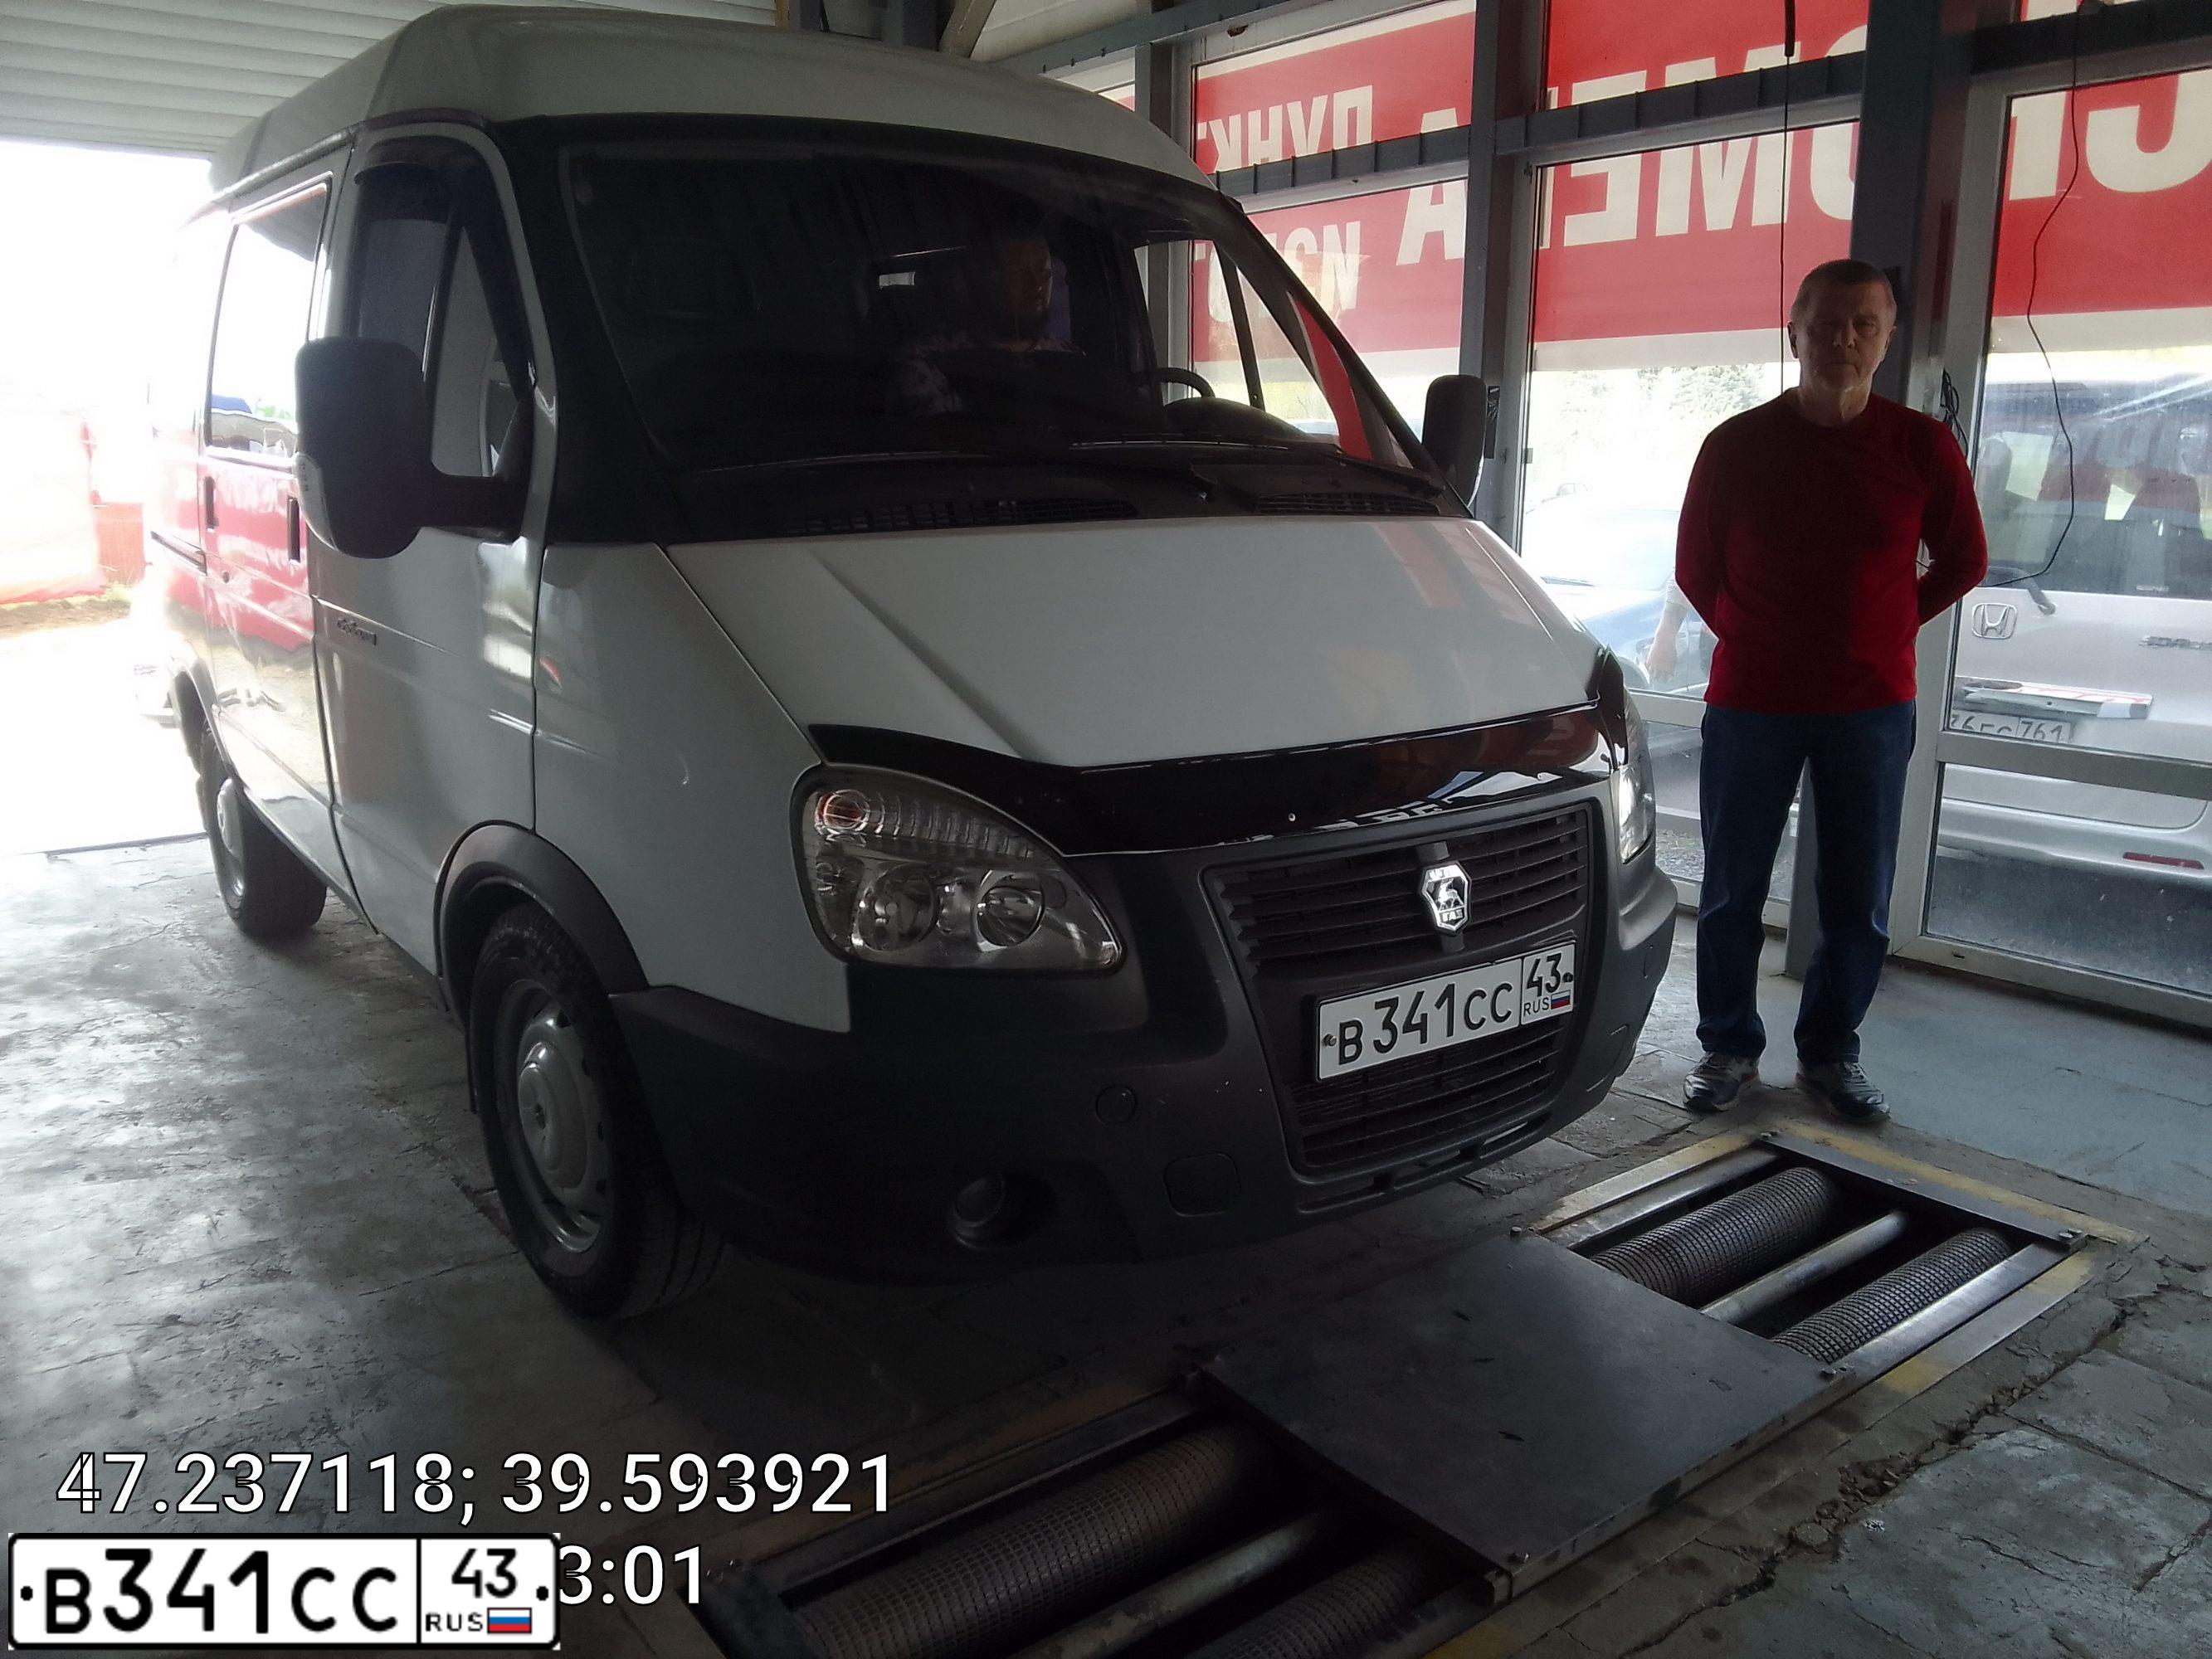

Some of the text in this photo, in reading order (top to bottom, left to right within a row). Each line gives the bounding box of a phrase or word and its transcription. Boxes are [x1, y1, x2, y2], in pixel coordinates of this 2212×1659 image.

[1337, 952, 1562, 1066] В341СС 43
[1523, 995, 1550, 1017] RUS
